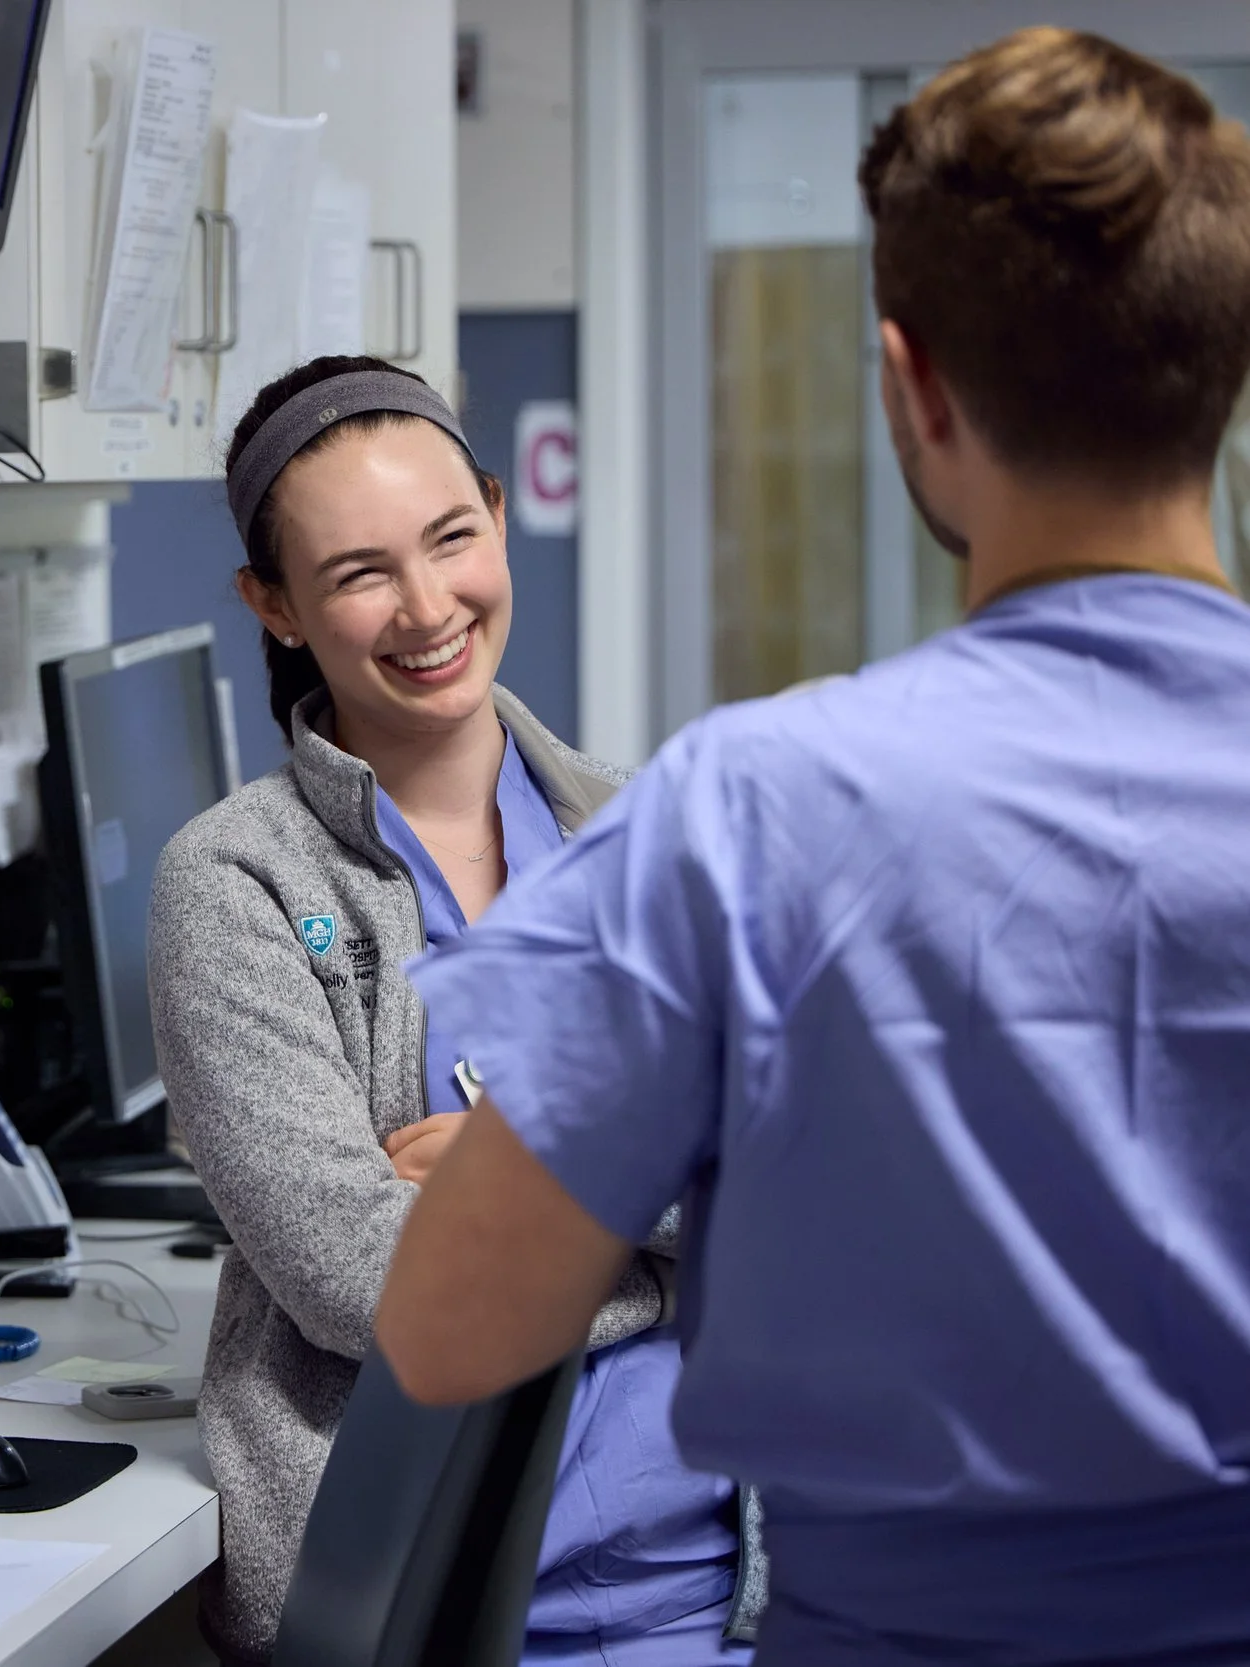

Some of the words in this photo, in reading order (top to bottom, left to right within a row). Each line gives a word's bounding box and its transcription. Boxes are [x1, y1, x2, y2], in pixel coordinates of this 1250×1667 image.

[529, 431, 578, 501] C
[306, 928, 331, 939] MGH
[311, 938, 328, 946] 1817
[324, 971, 348, 991] olly
